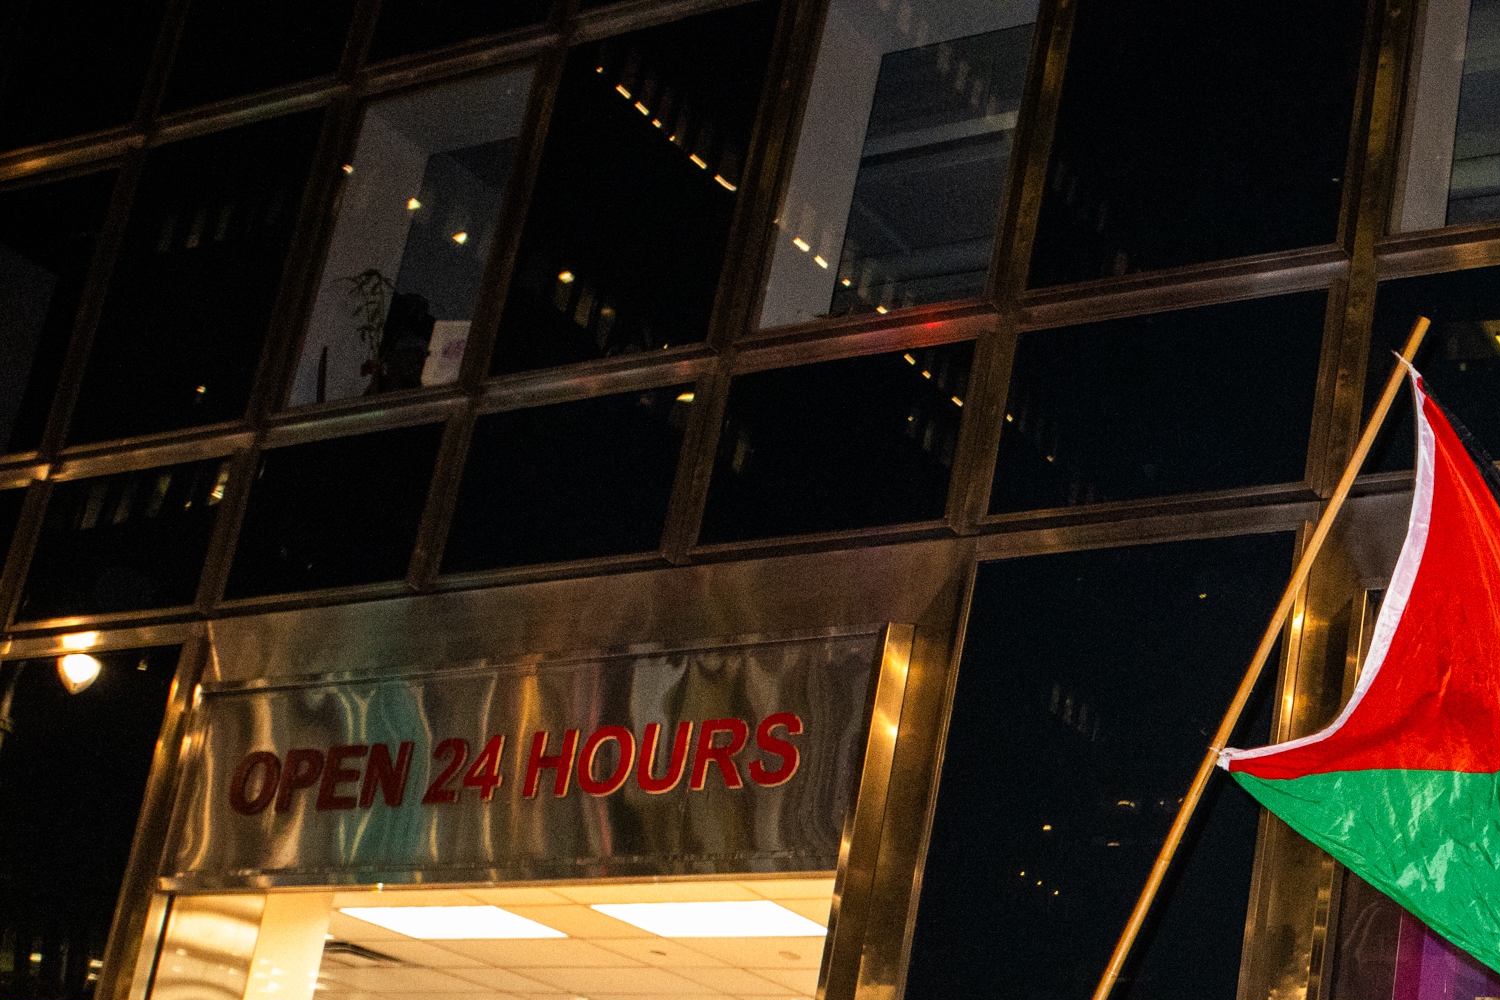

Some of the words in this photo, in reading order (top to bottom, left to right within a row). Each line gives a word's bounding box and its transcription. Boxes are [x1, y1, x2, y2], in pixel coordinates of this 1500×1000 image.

[230, 742, 412, 814] OPEN
[422, 734, 505, 805] 24
[523, 713, 802, 797] HOURS
